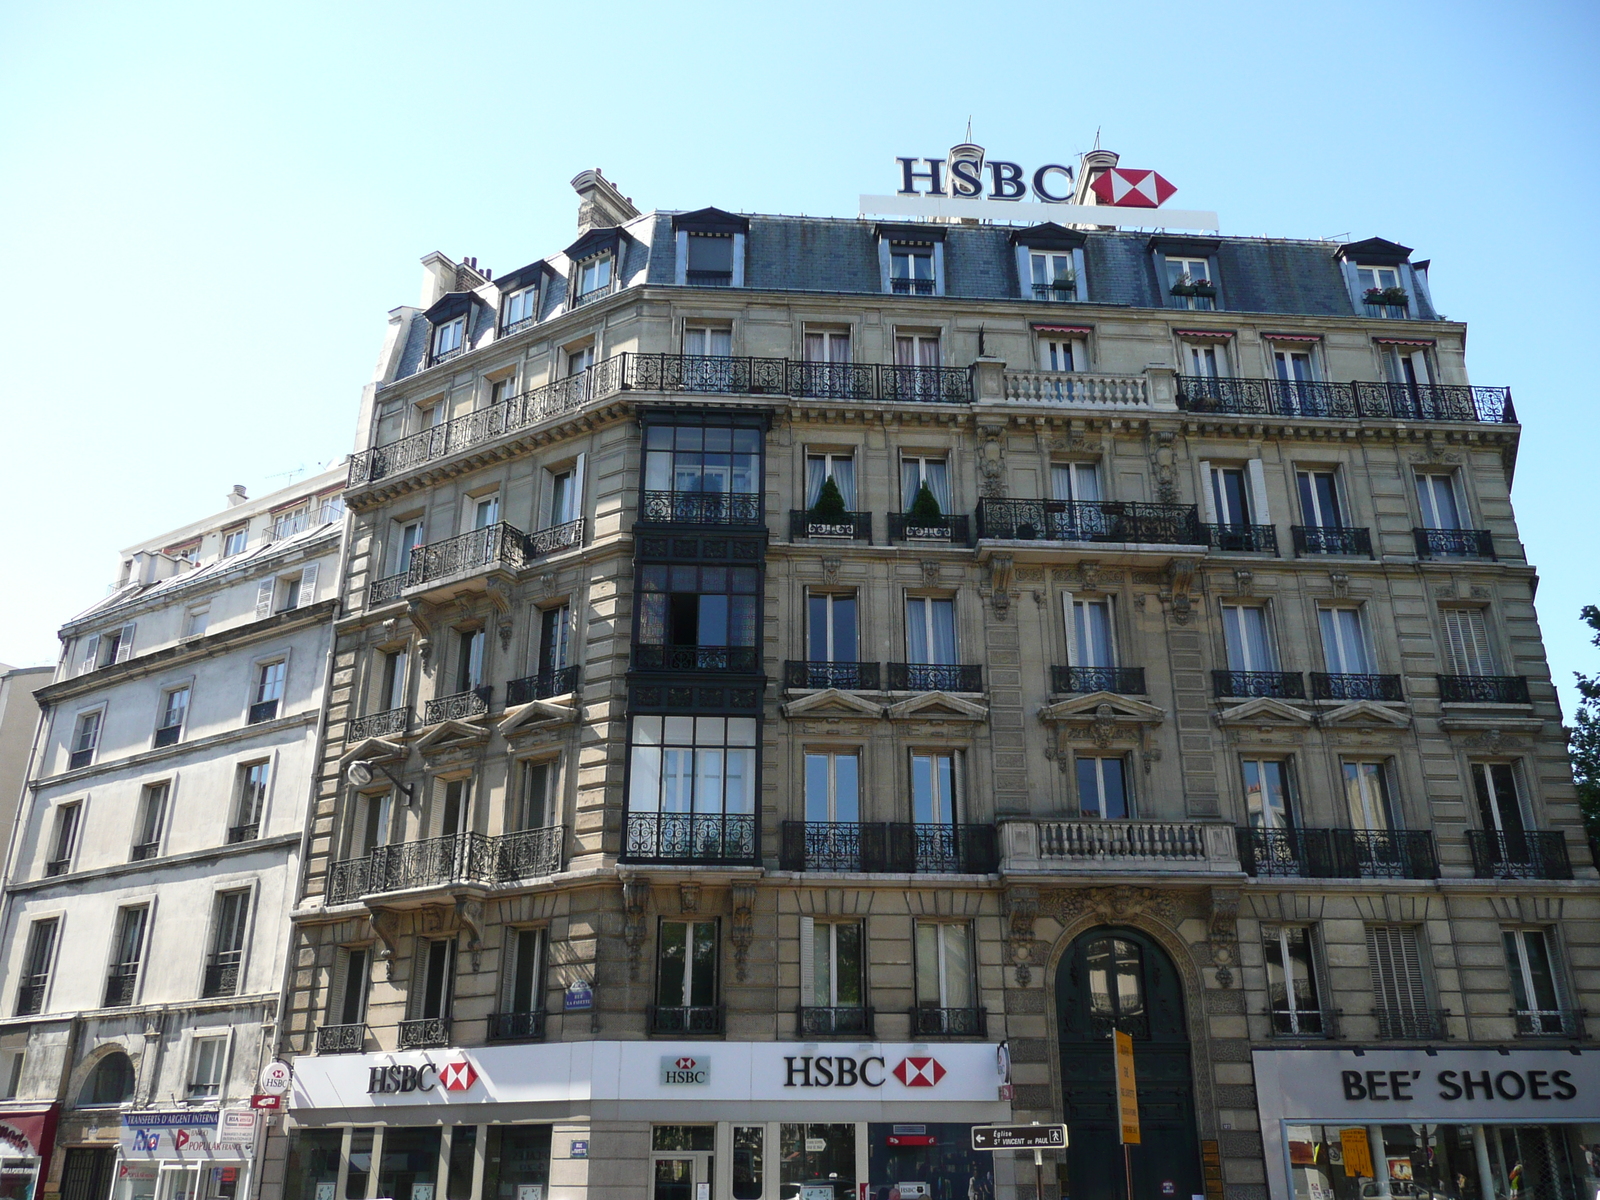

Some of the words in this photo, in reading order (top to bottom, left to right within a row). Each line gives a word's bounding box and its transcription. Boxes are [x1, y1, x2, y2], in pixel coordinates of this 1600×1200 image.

[895, 156, 1075, 203] HSBC
[366, 1063, 436, 1094] HSBC
[665, 1071, 705, 1084] HSBC
[783, 1056, 886, 1087] HSBC
[266, 1078, 287, 1088] HSBC
[1437, 1070, 1577, 1101] SHOES
[127, 1114, 161, 1125] TRANSFERTS
[161, 1113, 191, 1124] D'ARGENT
[132, 1128, 161, 1151] Ria
[993, 1129, 1012, 1138] Église
[188, 1141, 221, 1151] POPULAR
[222, 1143, 242, 1151] FRANCE
